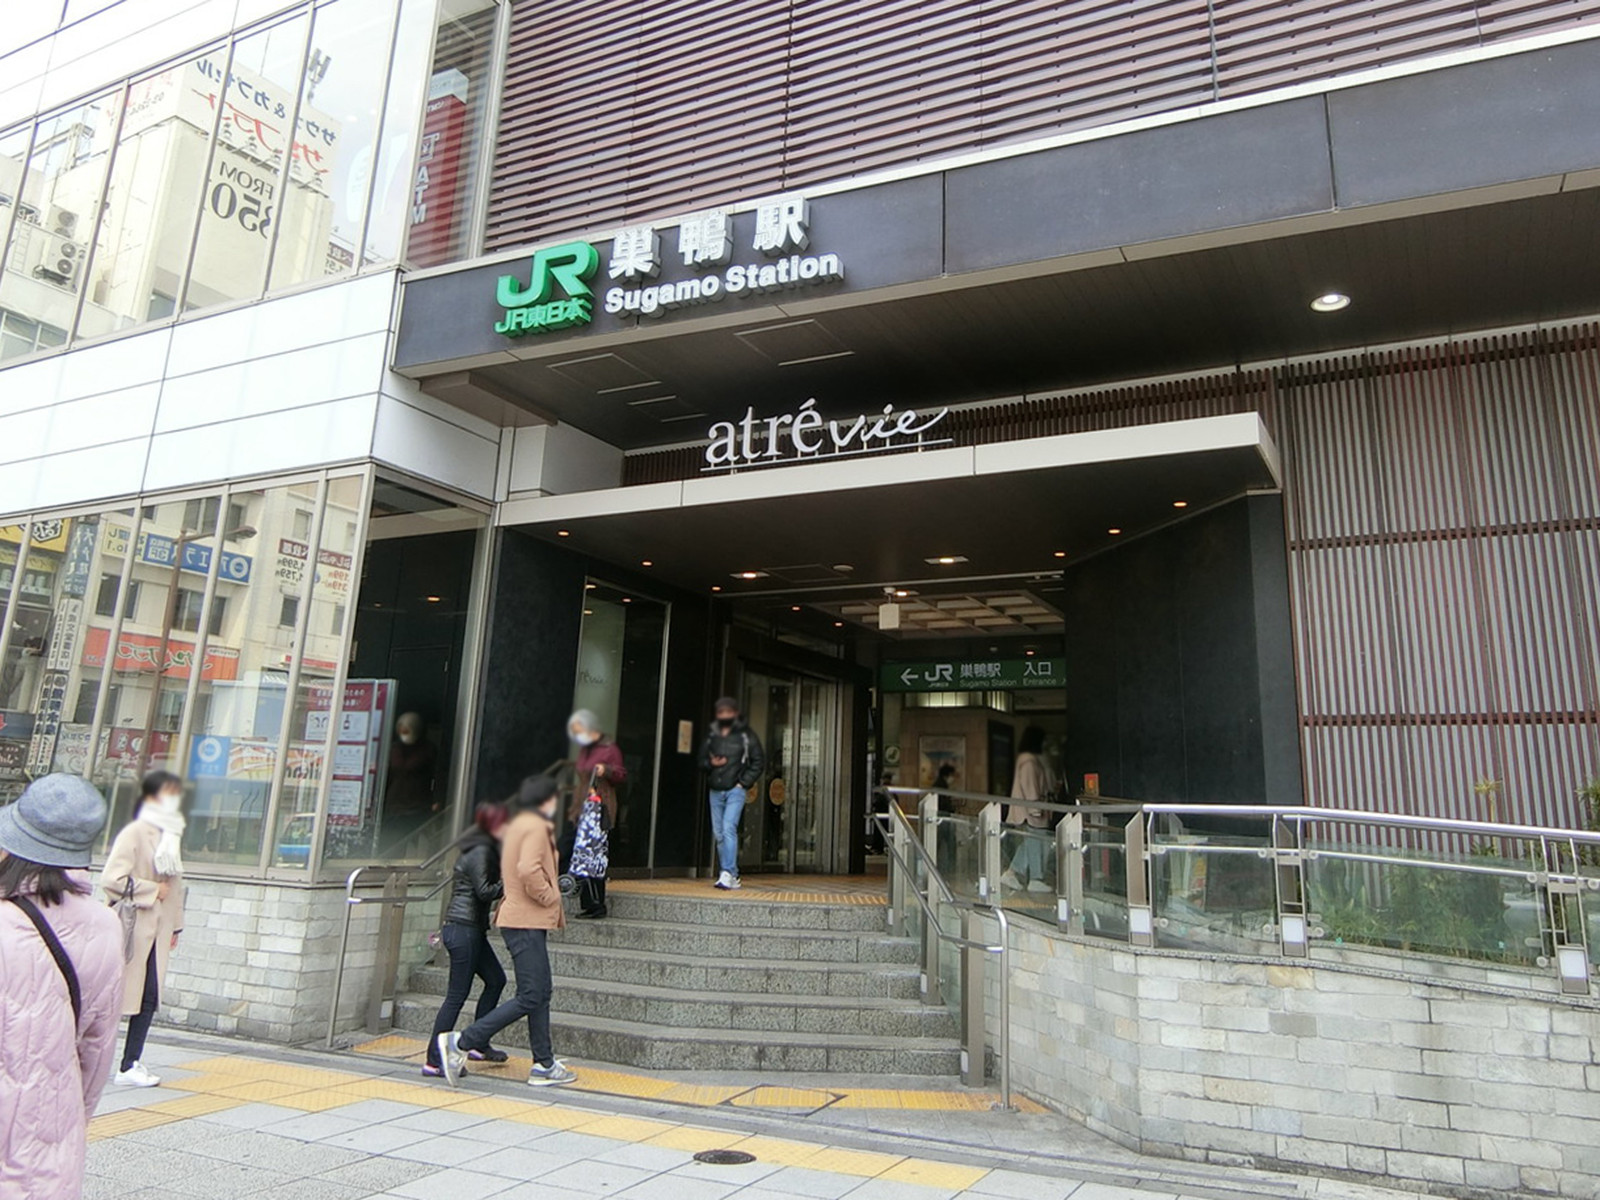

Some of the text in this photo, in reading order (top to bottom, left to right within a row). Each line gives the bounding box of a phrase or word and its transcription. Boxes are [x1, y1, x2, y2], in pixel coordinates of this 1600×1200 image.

[608, 196, 809, 281] 巣鴨駅
[496, 241, 598, 308] JR
[604, 252, 840, 317] Sugamo Station
[494, 298, 592, 337] JR東日本
[924, 664, 952, 682] JR
[959, 679, 990, 689] Sugamo
[991, 678, 1017, 688] Station
[1023, 677, 1057, 687] Entrance
[960, 661, 1052, 679] 巣鴨駅 入口
